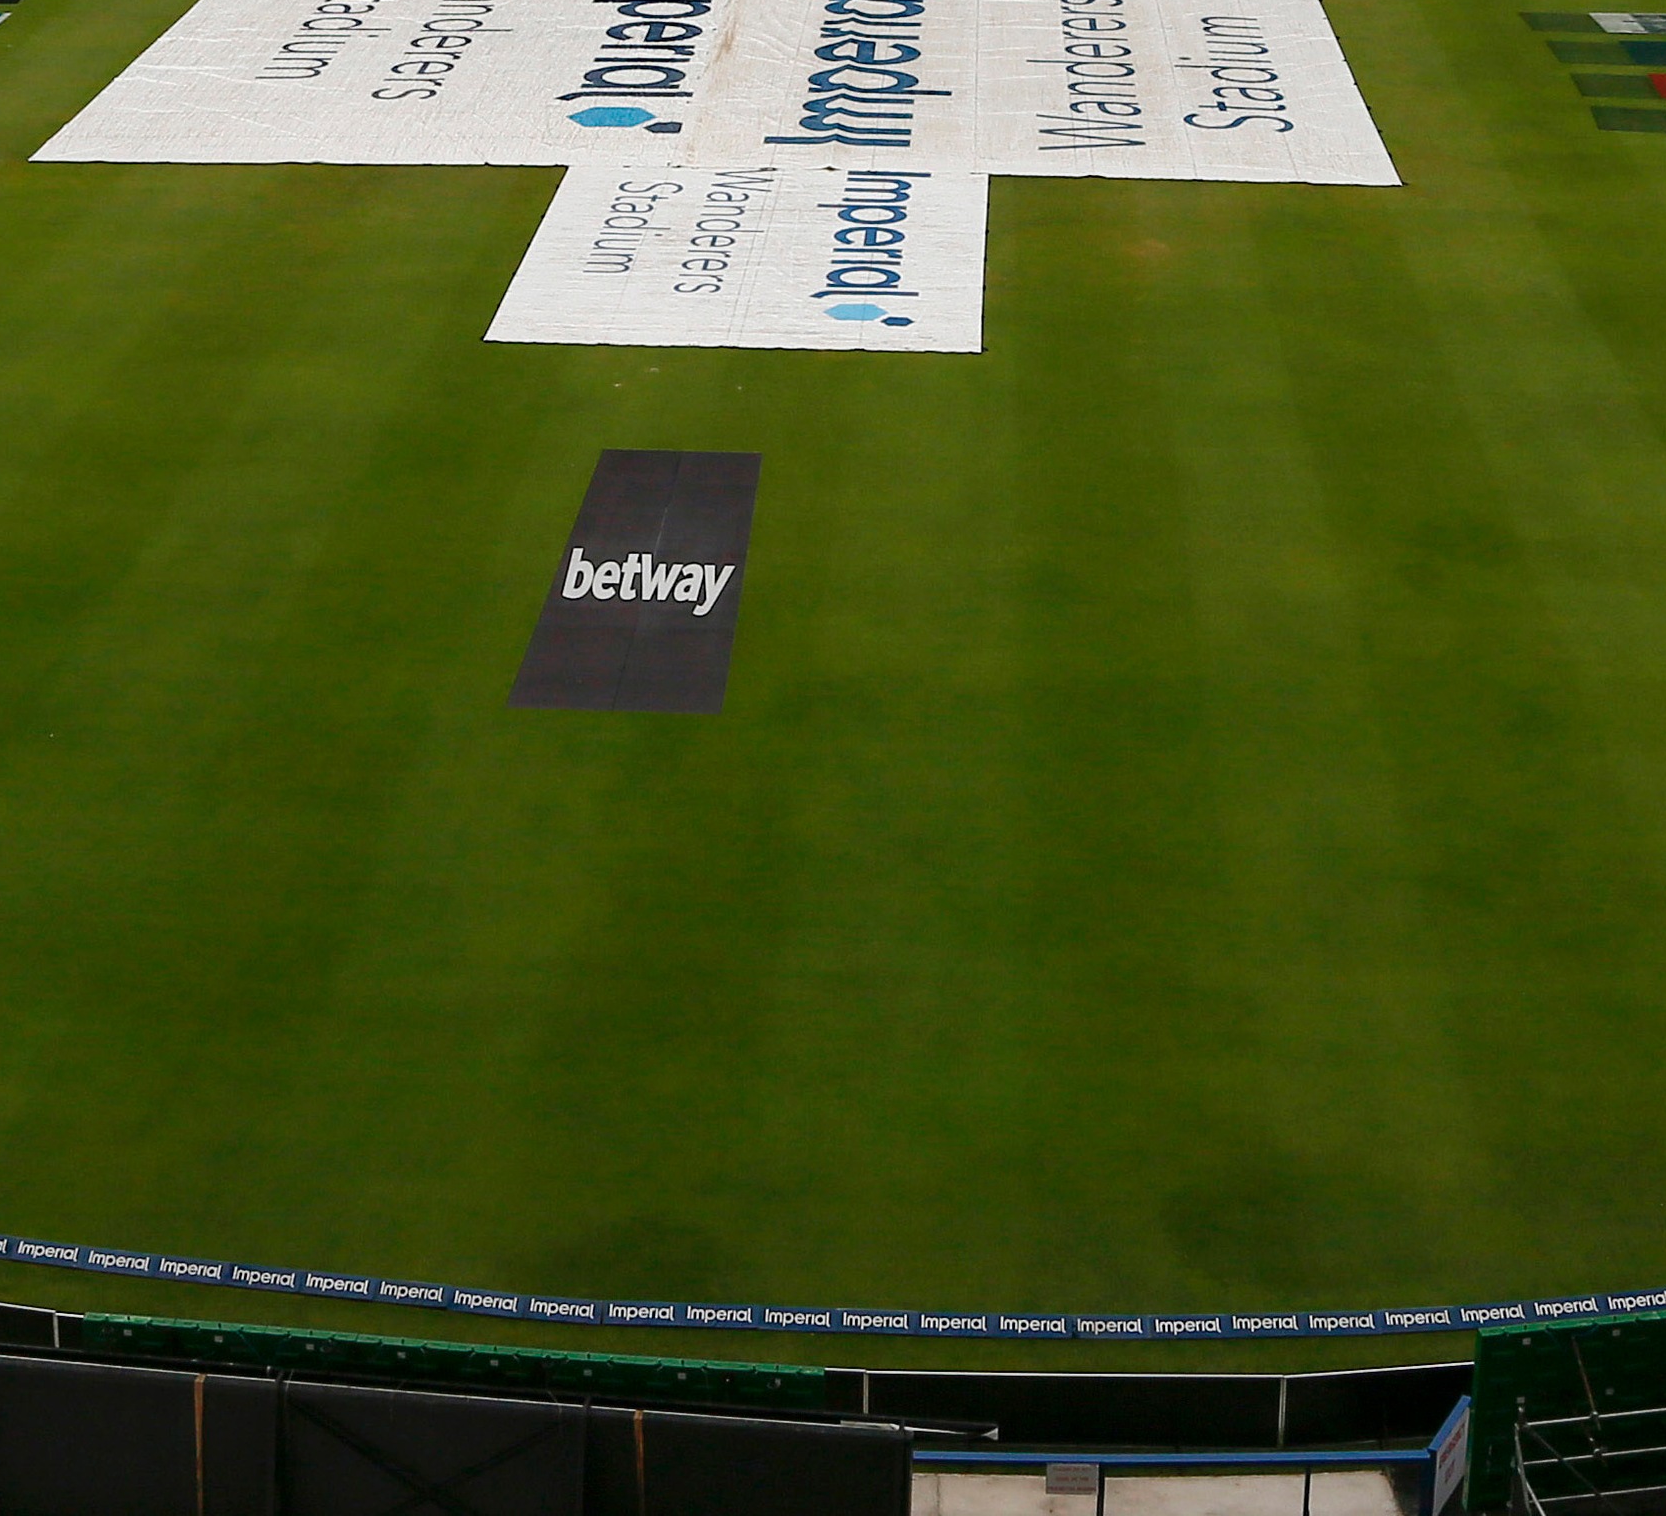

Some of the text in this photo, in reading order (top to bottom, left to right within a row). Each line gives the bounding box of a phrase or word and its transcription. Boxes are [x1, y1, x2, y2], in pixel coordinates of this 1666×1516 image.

[1174, 15, 1293, 133] Stadium
[582, 180, 683, 275] Stadium
[674, 167, 774, 295] Wanderers
[811, 171, 932, 299] Imperial
[562, 546, 736, 617] betway
[88, 1250, 150, 1272] Imperial
[609, 1303, 675, 1322] Imperial
[843, 1311, 909, 1331] Imperial
[1078, 1318, 1143, 1335] Imperial
[1385, 1309, 1451, 1328] Imperial
